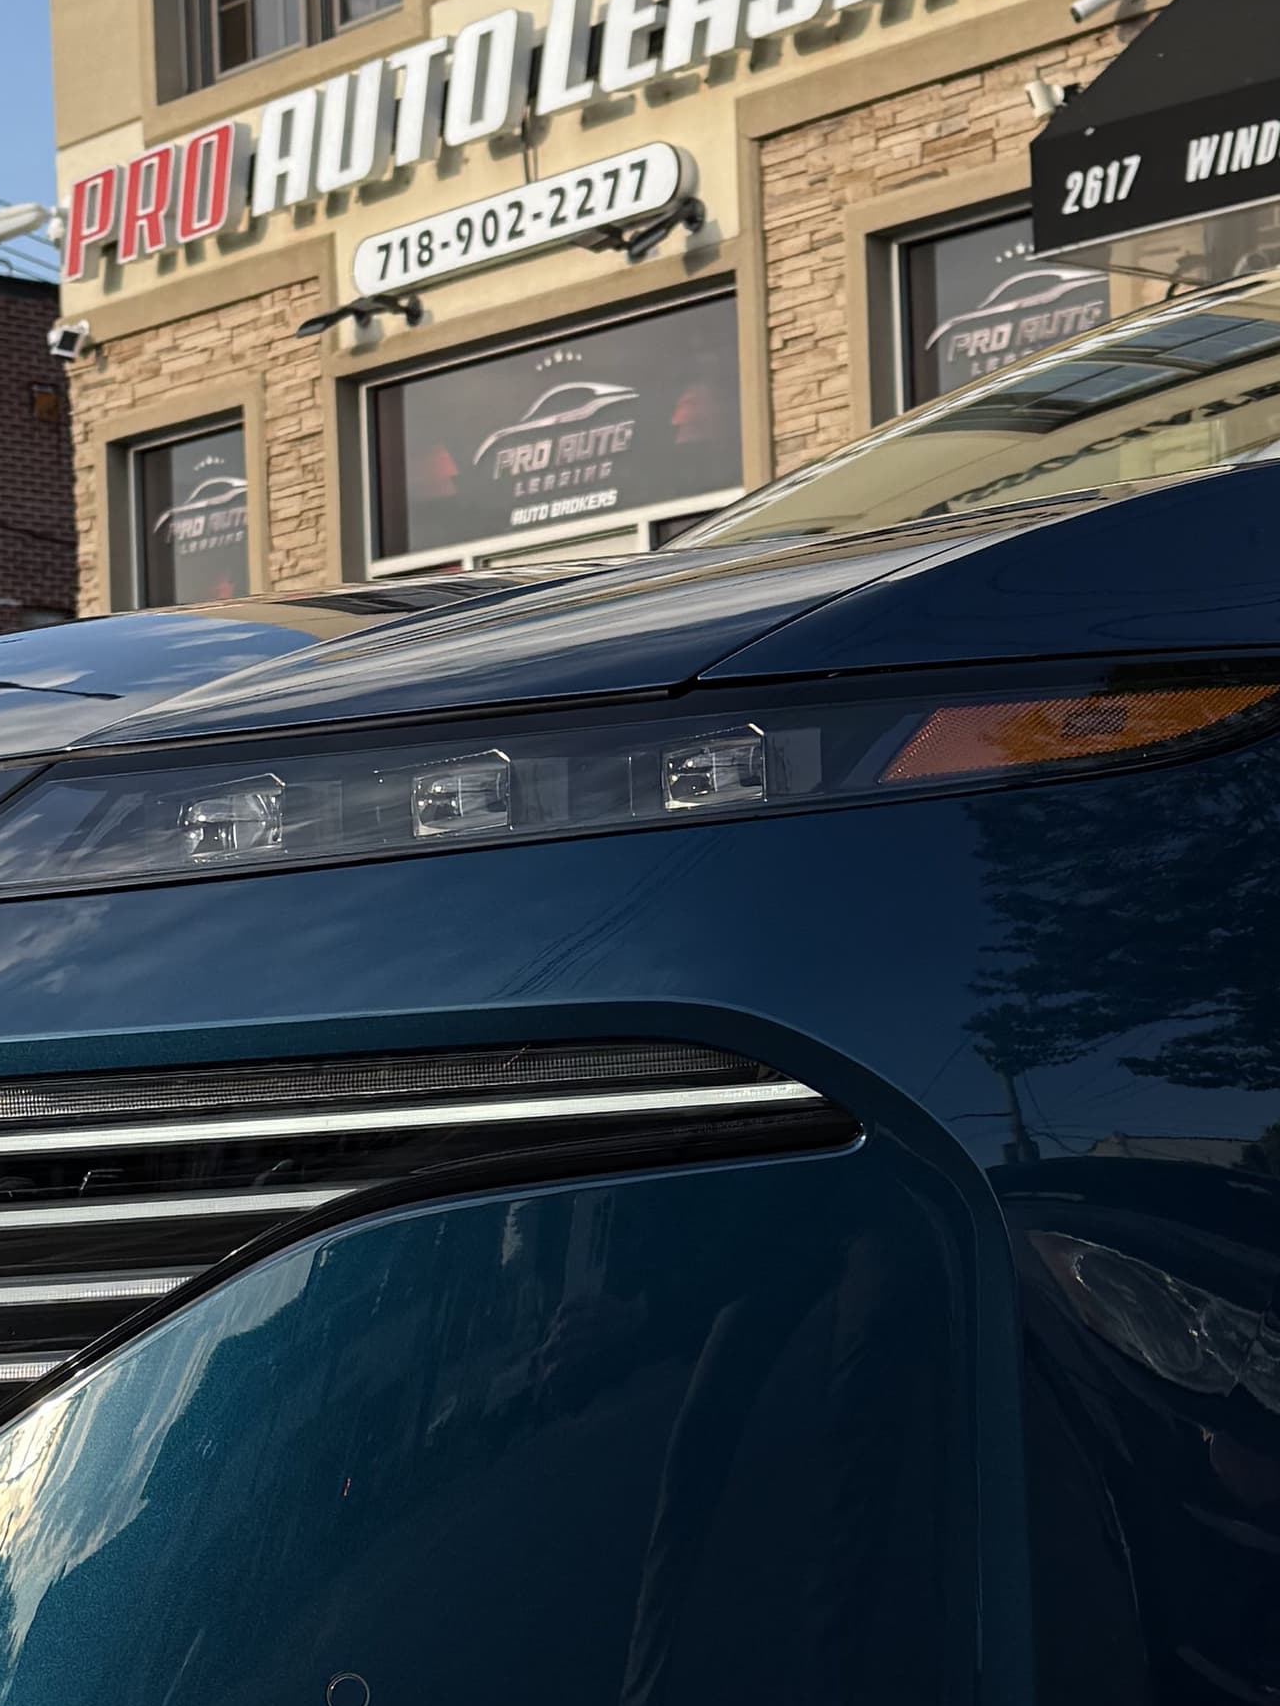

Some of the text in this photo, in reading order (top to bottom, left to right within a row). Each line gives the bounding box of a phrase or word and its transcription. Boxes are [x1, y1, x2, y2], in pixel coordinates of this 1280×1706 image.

[63, 119, 242, 281] PRO
[251, 7, 527, 217] AUTO
[1061, 154, 1141, 215] 2617
[376, 158, 650, 283] 718-902-2277
[947, 321, 1014, 363] PRO
[493, 420, 635, 480] PRO AUTO
[513, 461, 613, 497] LEASING
[510, 488, 619, 526] AUTO BROKERS
